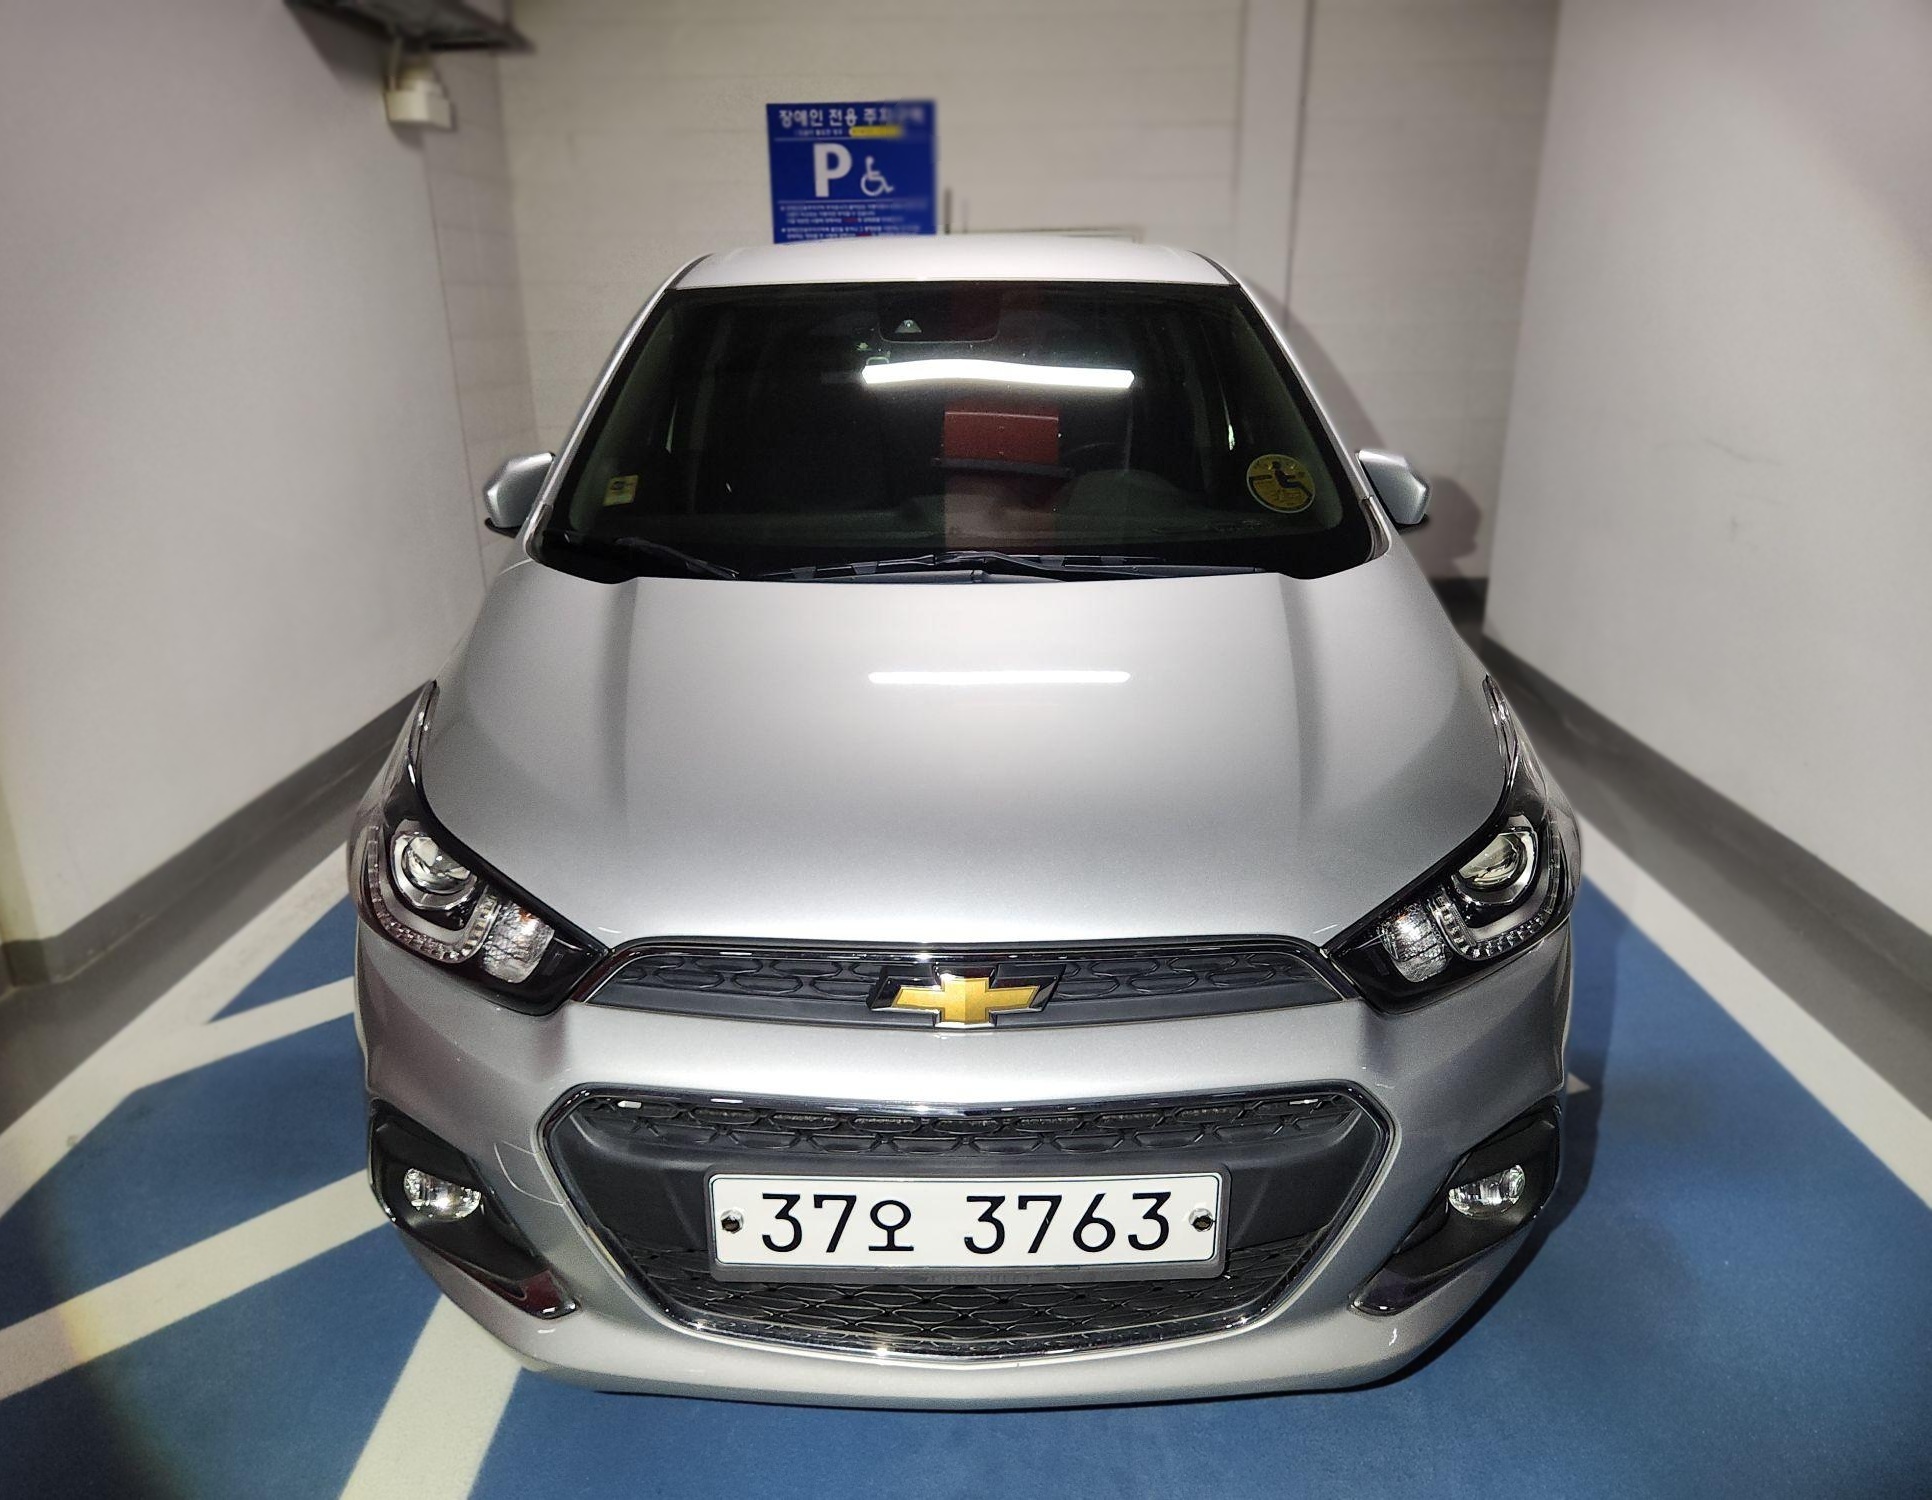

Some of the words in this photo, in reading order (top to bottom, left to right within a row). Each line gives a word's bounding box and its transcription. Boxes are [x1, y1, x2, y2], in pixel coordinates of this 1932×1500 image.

[779, 109, 824, 129] 장애인
[828, 107, 858, 127] 전용
[813, 143, 853, 198] P
[761, 1192, 915, 1254] 37오
[963, 1191, 1172, 1254] 3763
